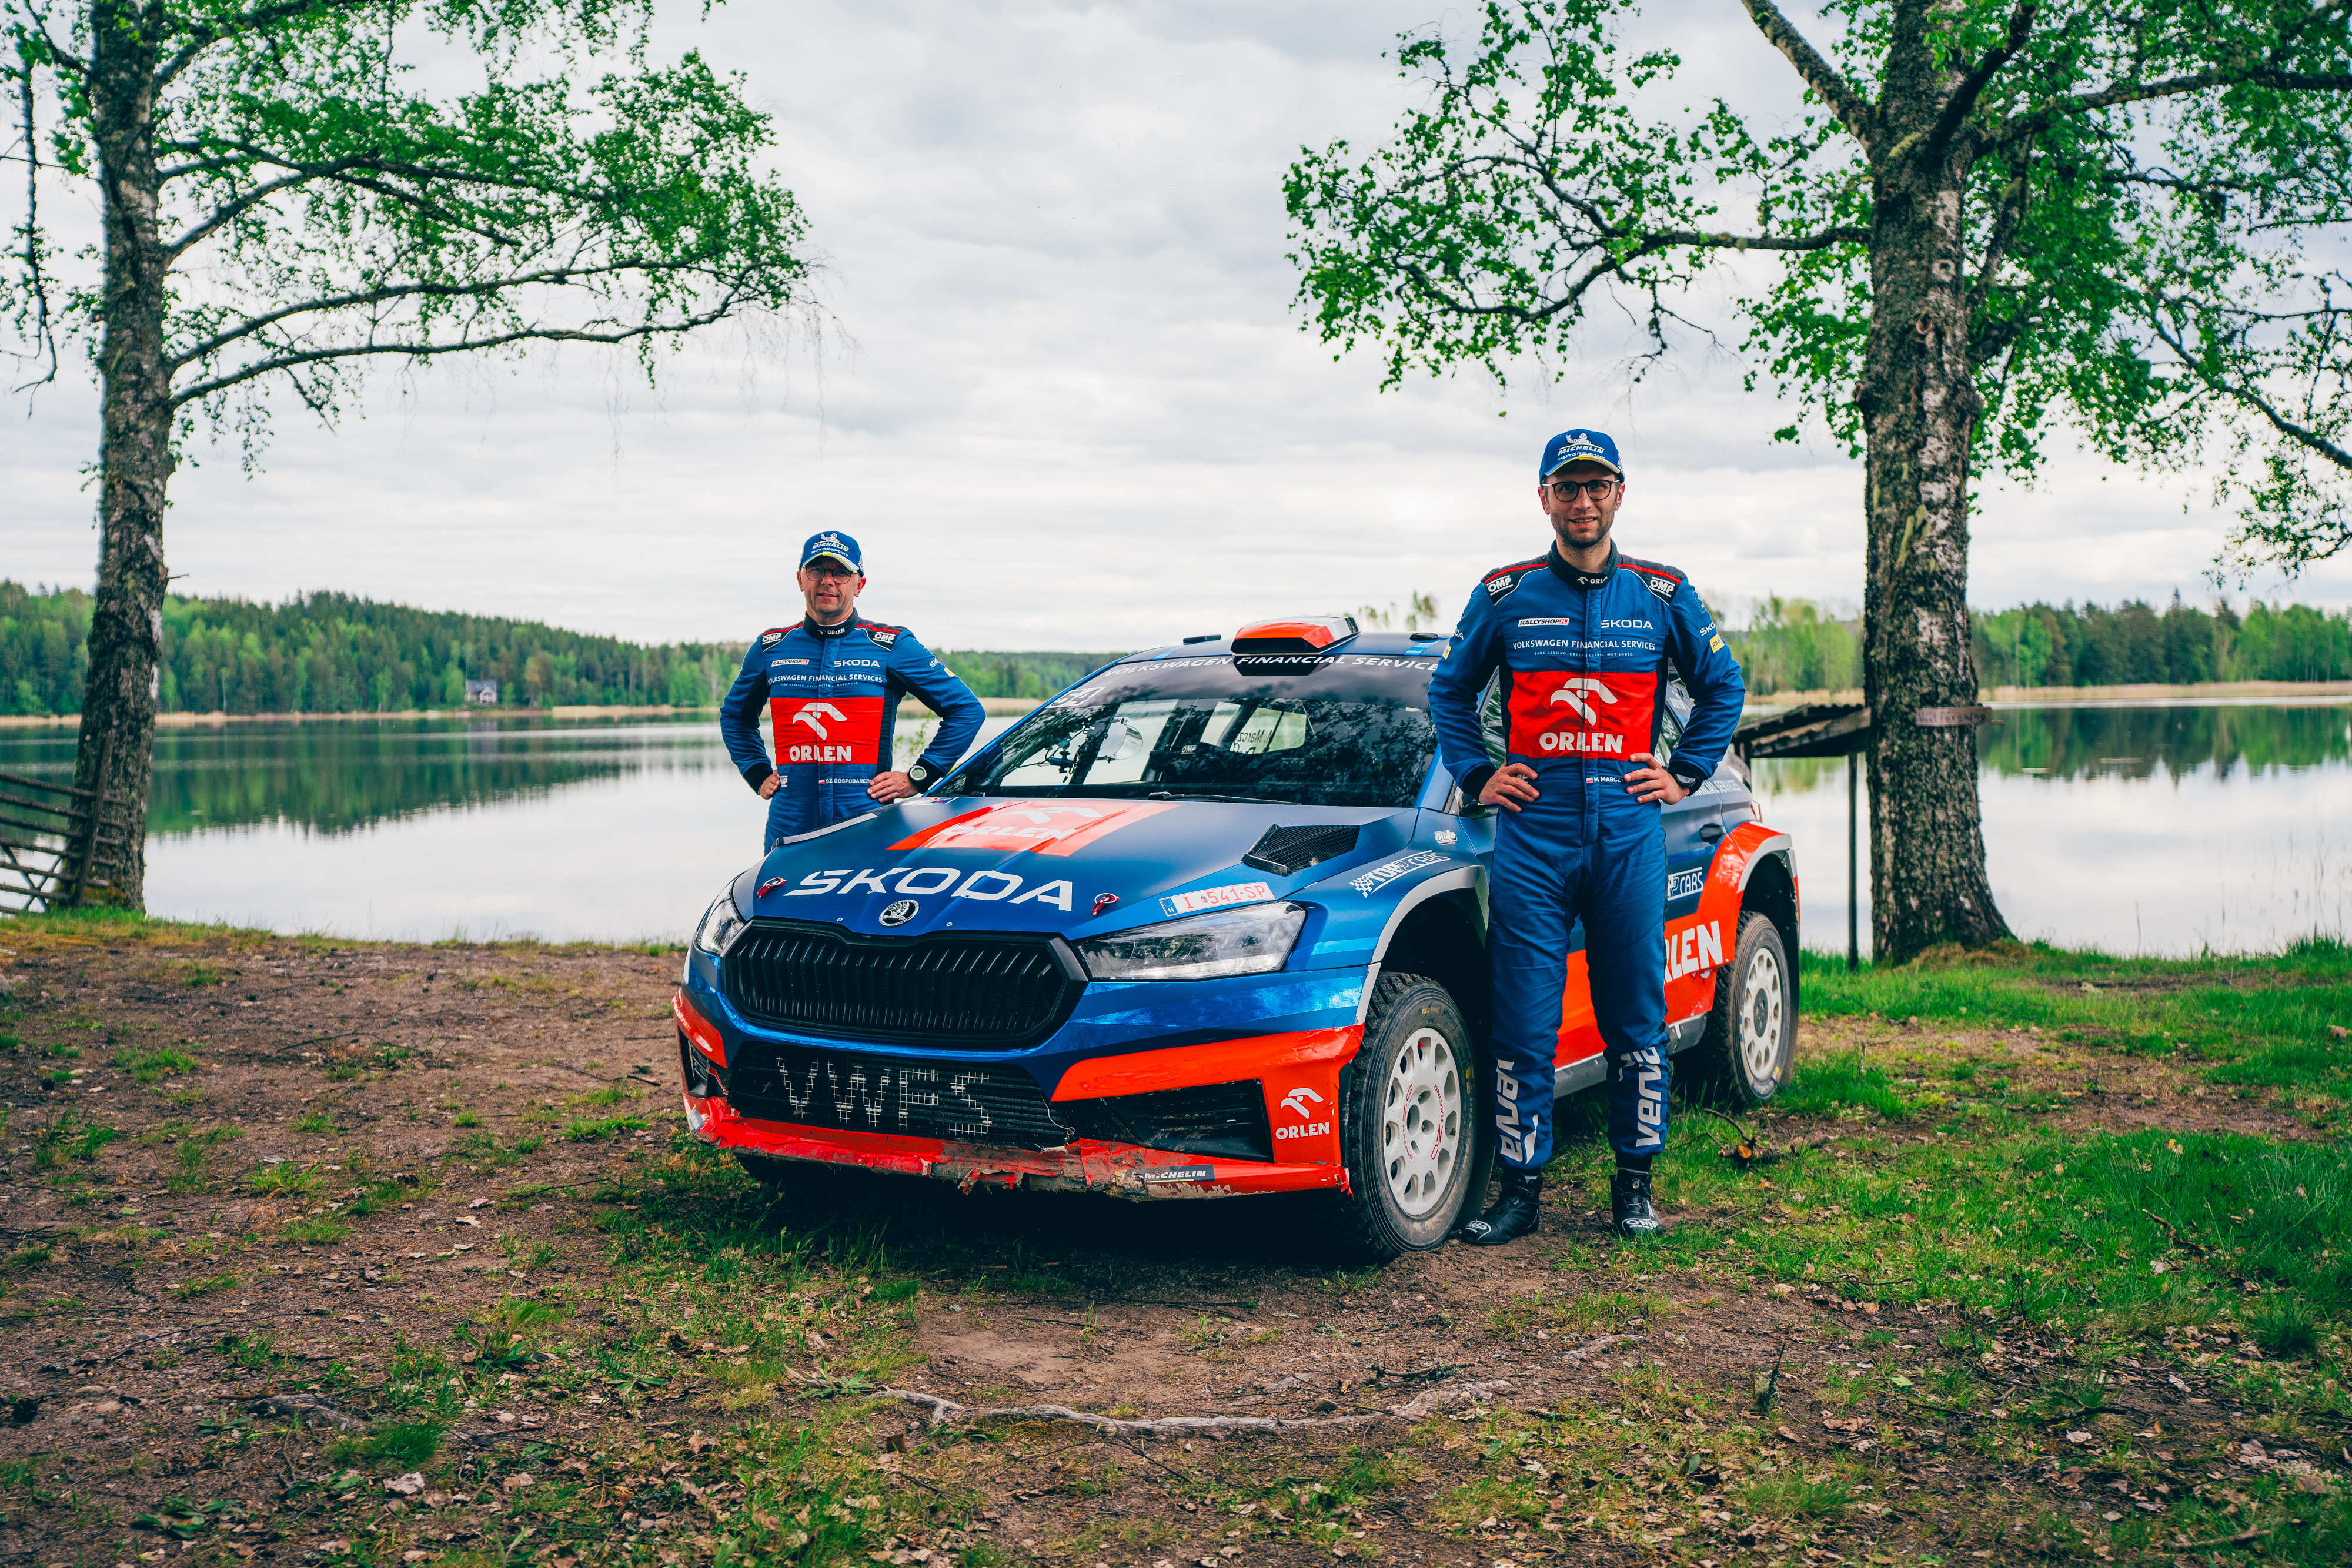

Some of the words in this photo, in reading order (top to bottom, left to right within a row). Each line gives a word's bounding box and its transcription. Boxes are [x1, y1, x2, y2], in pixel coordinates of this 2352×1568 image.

[1558, 445, 1604, 456] MICHELIN
[811, 542, 849, 552] MICHELIN
[811, 547, 849, 557] MOTORSPORT
[1488, 577, 1512, 593] OMP
[1650, 579, 1675, 593] OMP
[1600, 619, 1653, 630] SKODA
[762, 634, 781, 643] OMP
[874, 633, 894, 641] OMP
[1513, 639, 1568, 650] VOLKSWAGEN
[1572, 640, 1620, 649] FINANCIAL
[1621, 641, 1656, 651] SERVICES
[834, 659, 880, 668] SKODA
[1105, 657, 1233, 677] VOLKSWAGEN
[1236, 656, 1345, 665] FINANCIAL
[1352, 657, 1439, 671] SERVICE
[767, 674, 806, 685] VOLKSWAGEN
[849, 674, 883, 683] SERVICES
[1048, 687, 1104, 707] 54
[1539, 731, 1623, 753] ORLEN
[789, 745, 852, 762] ORLEN
[943, 825, 1077, 840] ORLEN
[783, 867, 1073, 911] SKODA
[1680, 872, 1703, 894] CARS
[1206, 885, 1265, 904] 541-SP
[1275, 1122, 1330, 1139] ORLEN
[1144, 1170, 1206, 1179] MCHELIN
